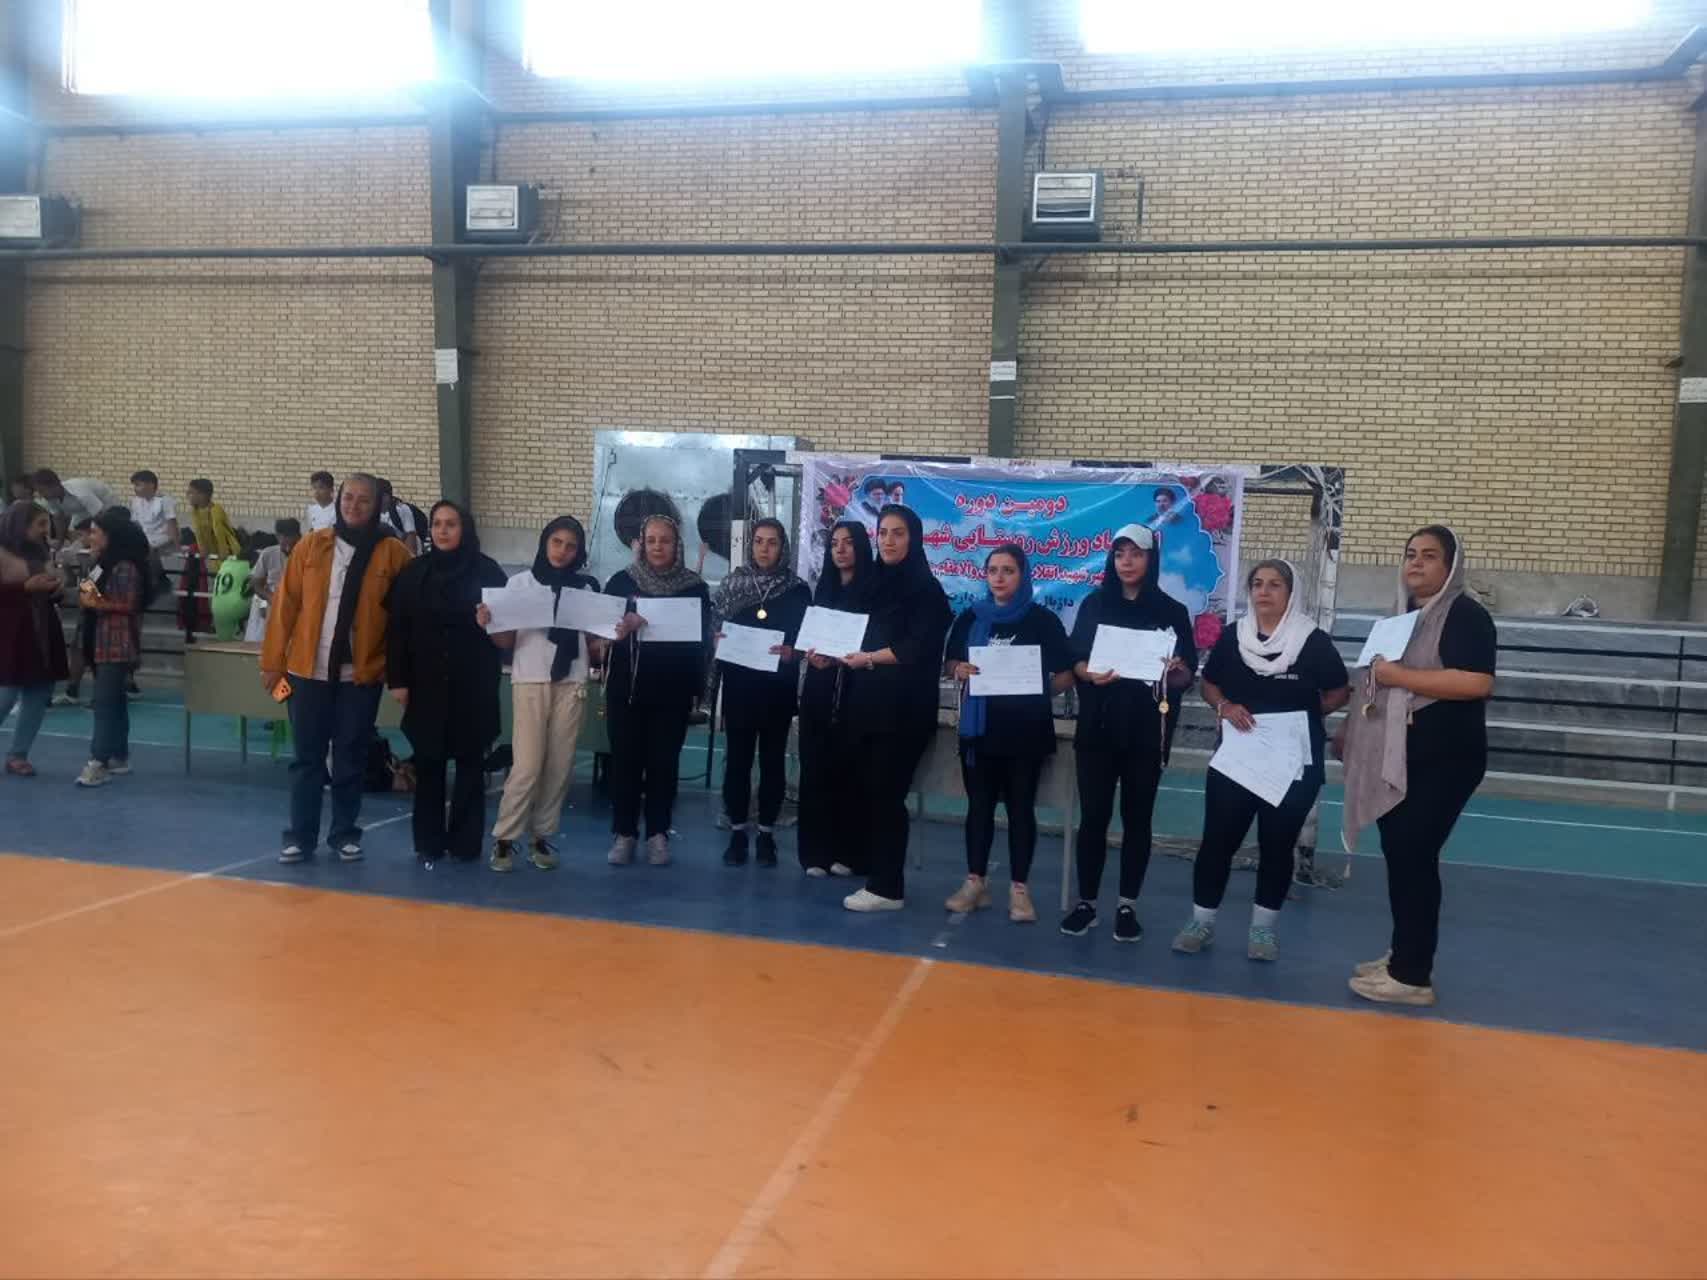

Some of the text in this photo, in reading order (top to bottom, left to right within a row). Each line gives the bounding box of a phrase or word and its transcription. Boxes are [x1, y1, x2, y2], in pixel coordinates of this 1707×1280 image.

[955, 492, 1068, 519] دومین دوره
[952, 524, 1036, 554] روستایی
[1036, 527, 1090, 558] ورزش
